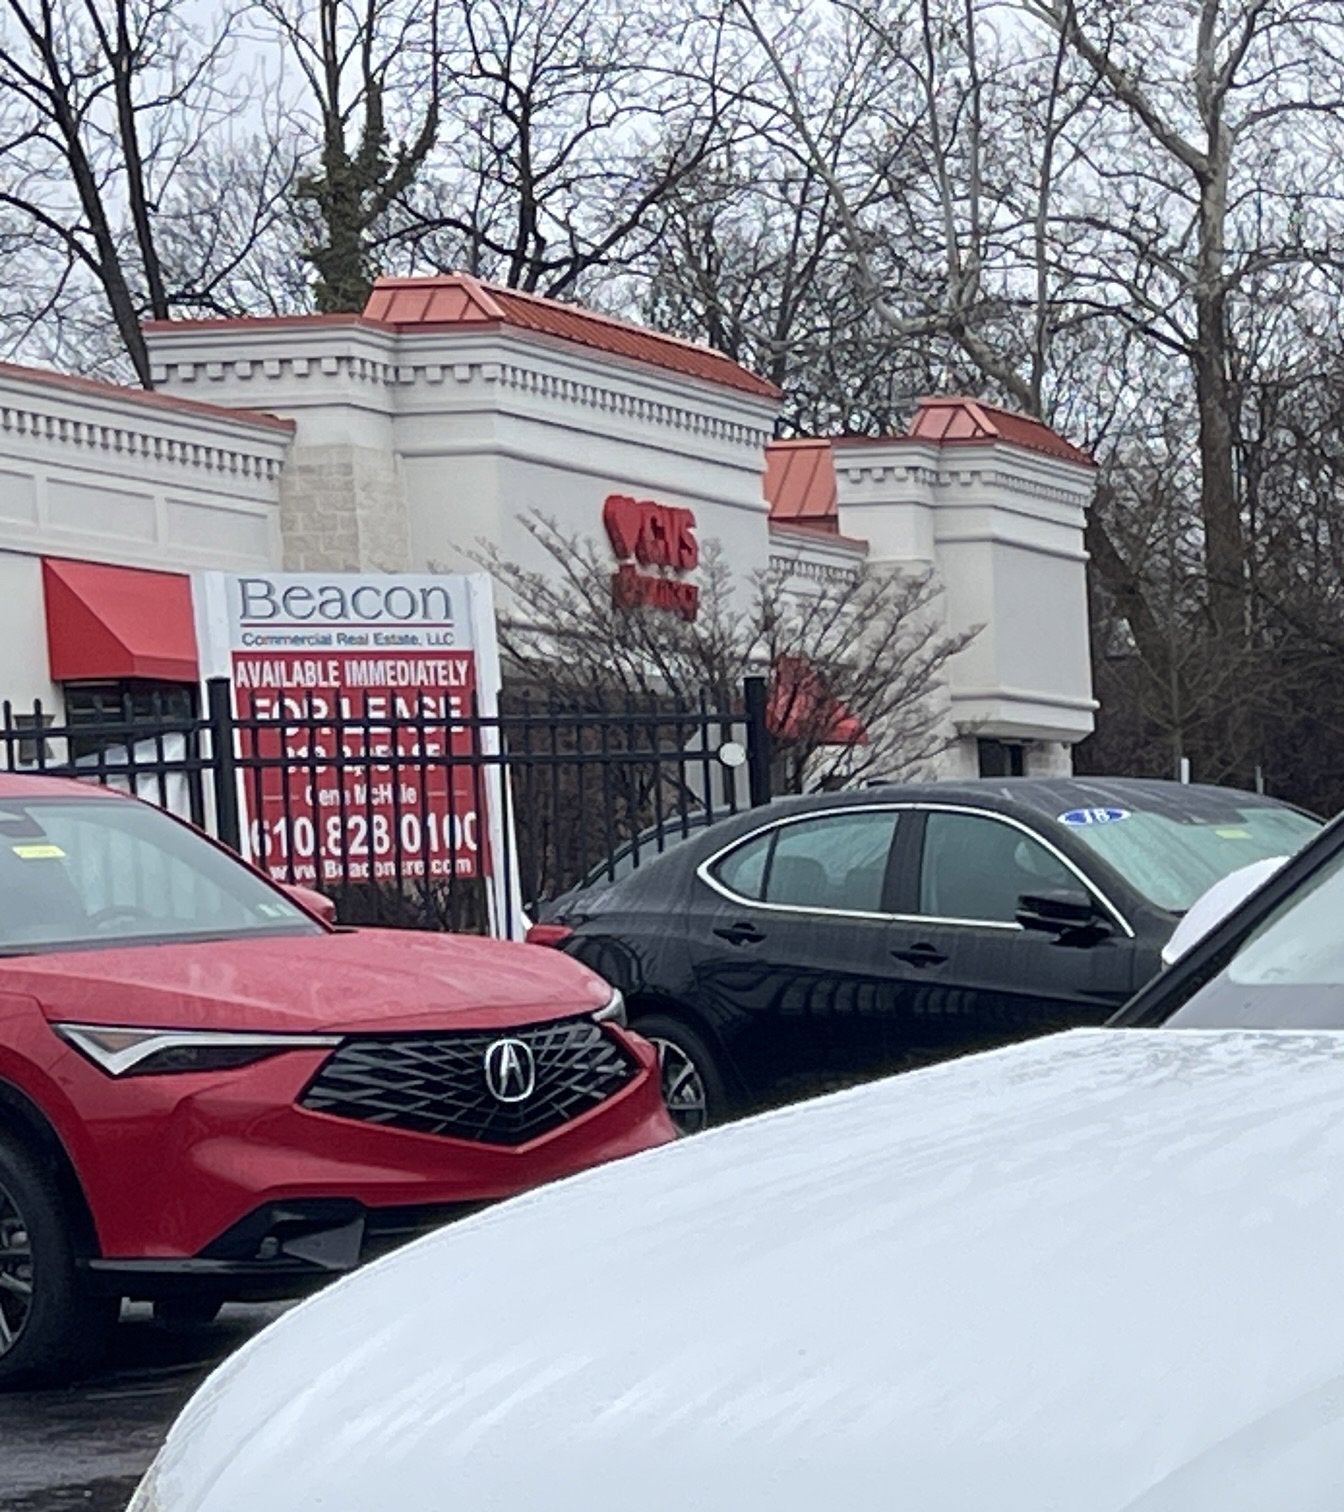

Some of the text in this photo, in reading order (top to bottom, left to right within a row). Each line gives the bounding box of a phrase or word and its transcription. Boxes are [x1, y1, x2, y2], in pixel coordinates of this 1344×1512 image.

[238, 578, 454, 620] Beacon
[241, 632, 332, 646] Commercial
[336, 632, 369, 646] Real
[427, 632, 455, 646] LLC
[236, 659, 469, 689] AVAILABLE IMMEDIATELY
